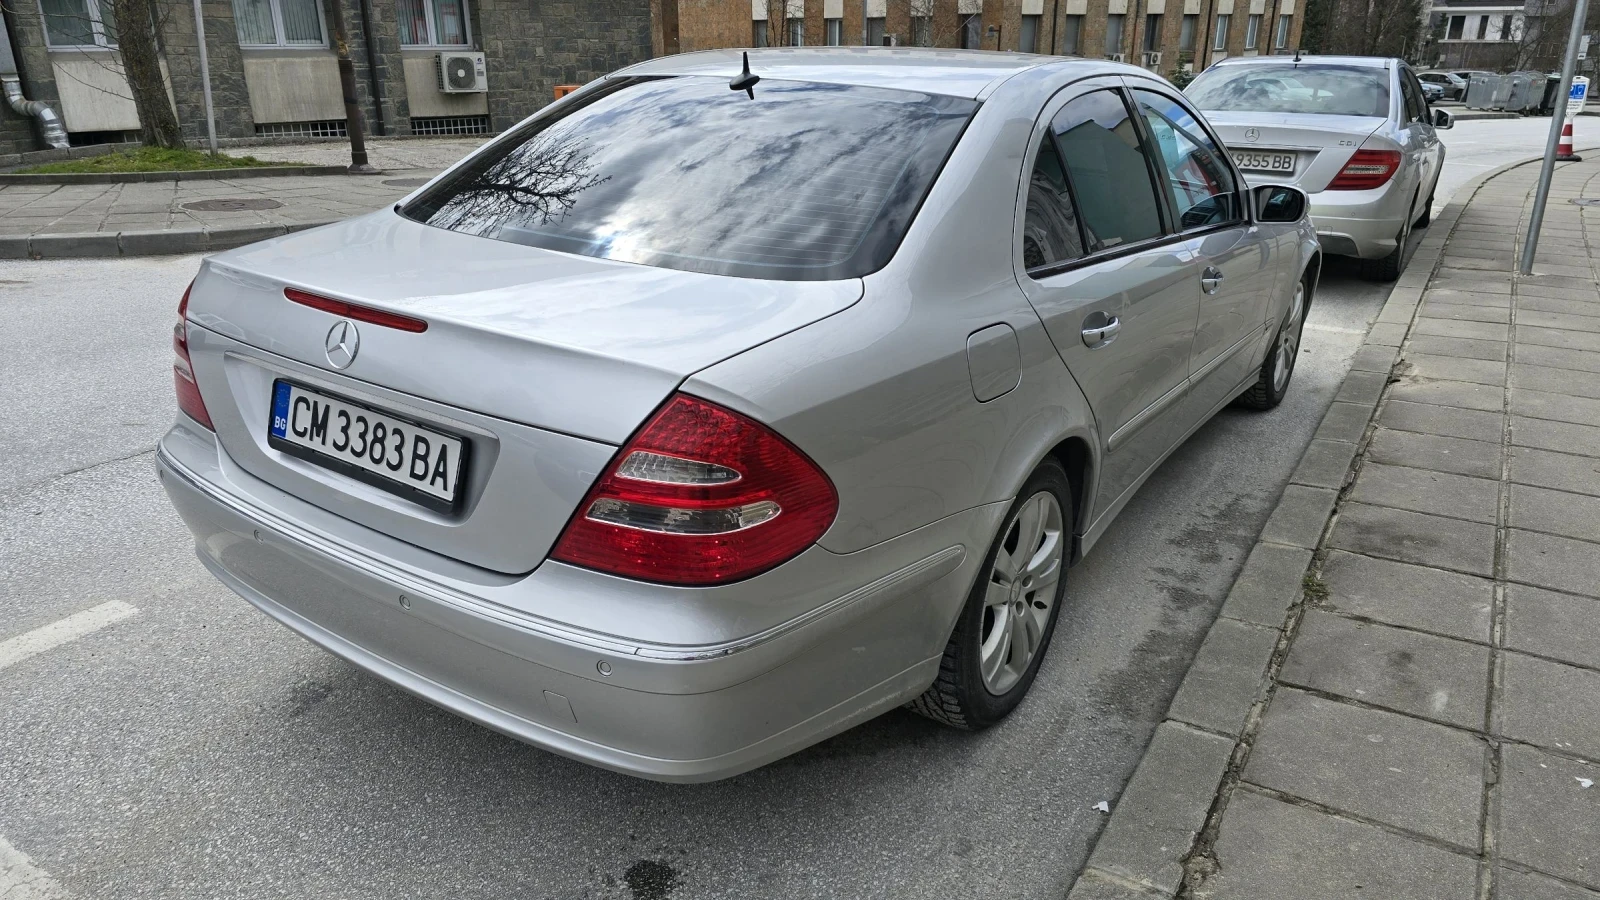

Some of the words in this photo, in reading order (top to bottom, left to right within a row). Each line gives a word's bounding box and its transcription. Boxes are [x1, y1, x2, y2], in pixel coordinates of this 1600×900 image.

[1236, 153, 1270, 168] 9355
[1272, 155, 1292, 169] BB
[274, 415, 286, 430] BG
[291, 396, 330, 446] CM
[332, 409, 405, 472] 3383
[409, 434, 448, 491] BA
